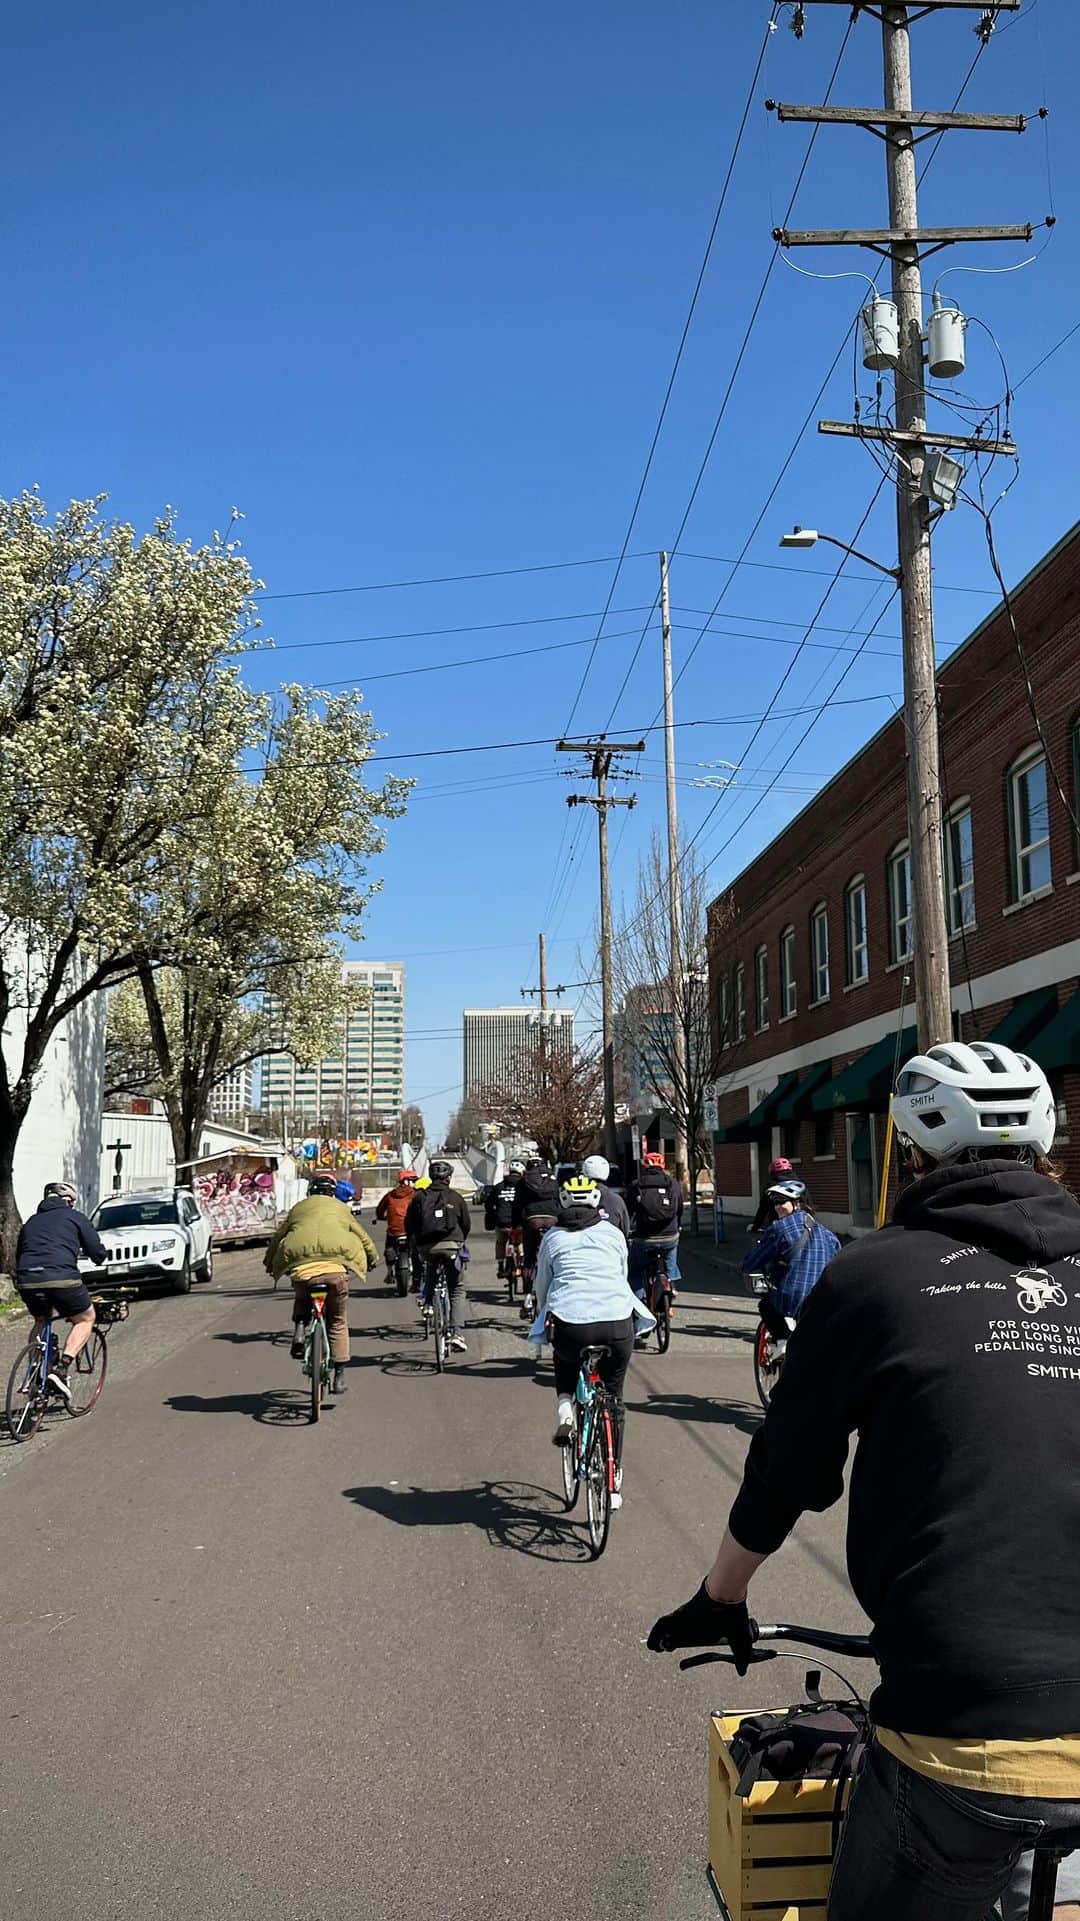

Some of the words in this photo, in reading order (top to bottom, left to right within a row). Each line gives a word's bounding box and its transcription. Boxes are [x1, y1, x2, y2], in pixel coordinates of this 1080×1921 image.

[911, 1094, 935, 1108] SMITH
[940, 1246, 979, 1265] SMITH
[965, 1280, 981, 1290] the
[984, 1281, 1007, 1290] hills
[988, 1320, 1016, 1330] FOR
[1021, 1321, 1060, 1333] GOOD
[990, 1331, 1020, 1340] AND
[1024, 1331, 1062, 1343] LONG
[974, 1341, 1045, 1353] PEDALING
[1026, 1363, 1080, 1380] SMITH
